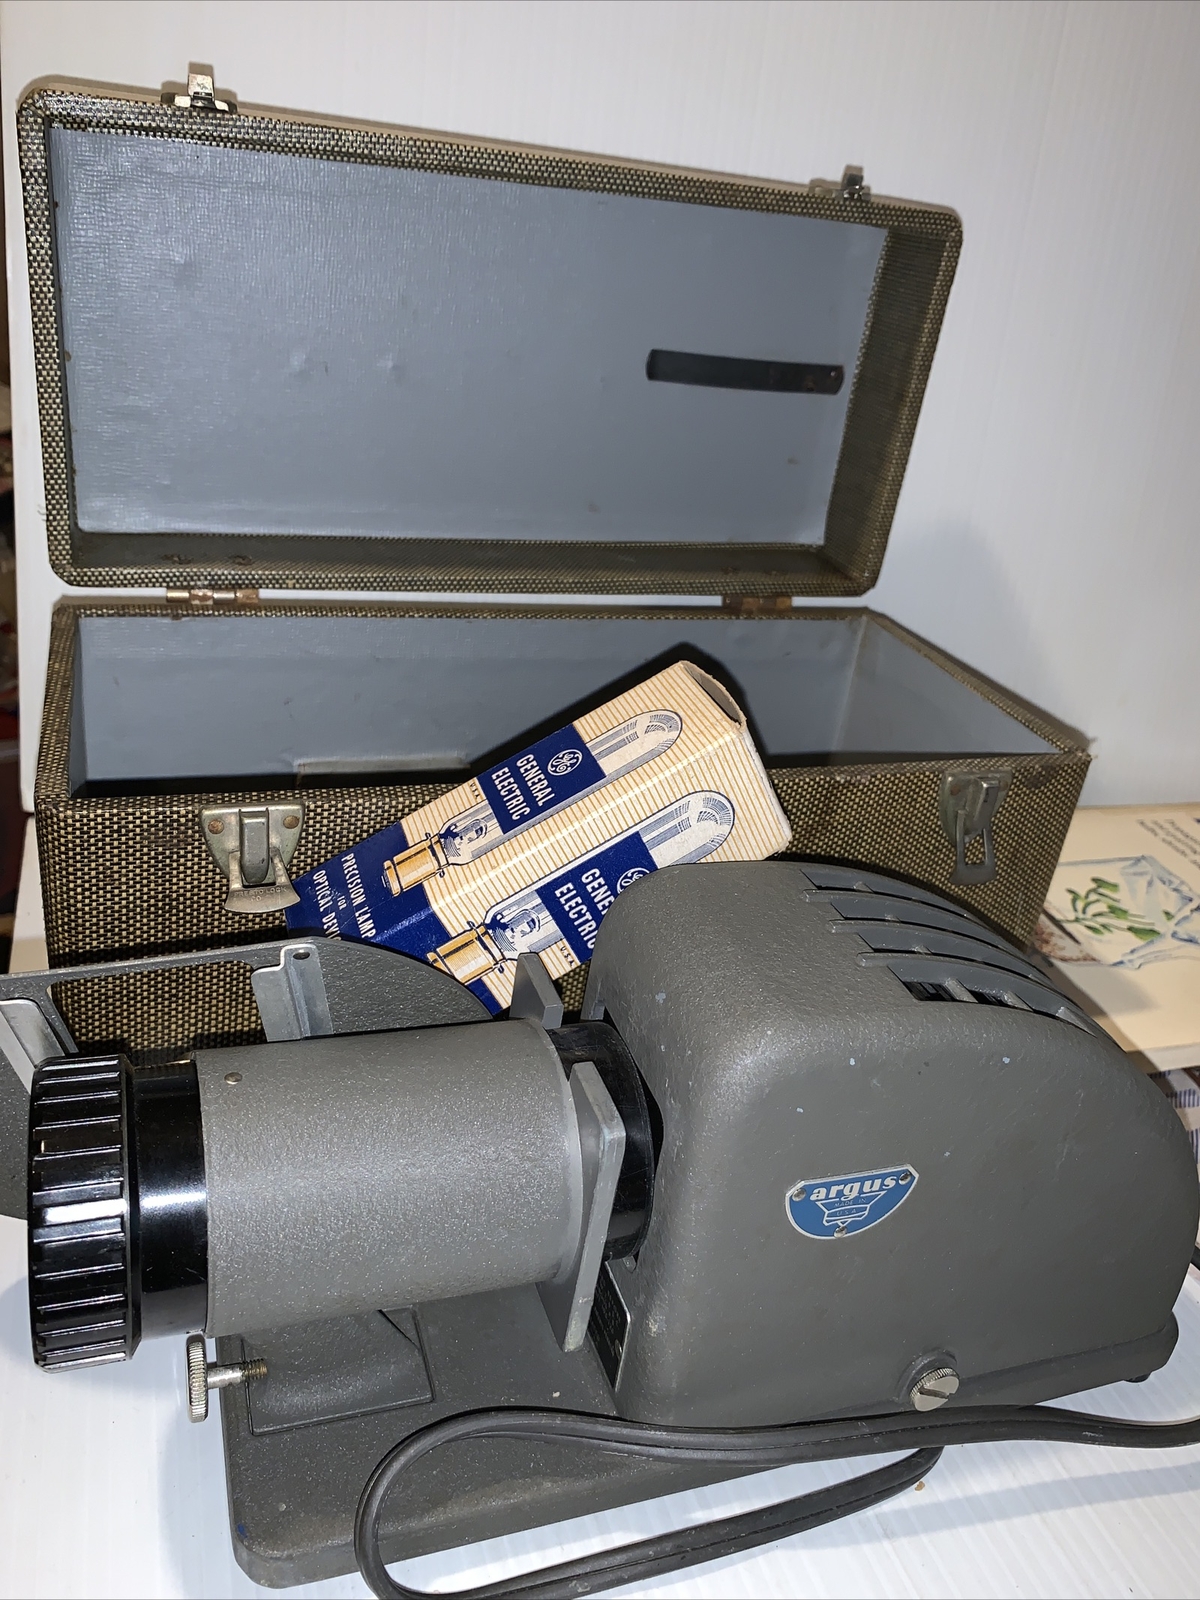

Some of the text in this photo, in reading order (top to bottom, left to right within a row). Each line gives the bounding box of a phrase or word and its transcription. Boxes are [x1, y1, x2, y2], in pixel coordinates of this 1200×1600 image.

[491, 767, 531, 820] ELECTRIC
[516, 754, 555, 807] GENERAL
[313, 870, 341, 940] OPTICAL DEVI
[341, 853, 376, 938] PRECISION LAMP
[581, 868, 615, 915] GENE
[809, 1175, 897, 1201] argus
